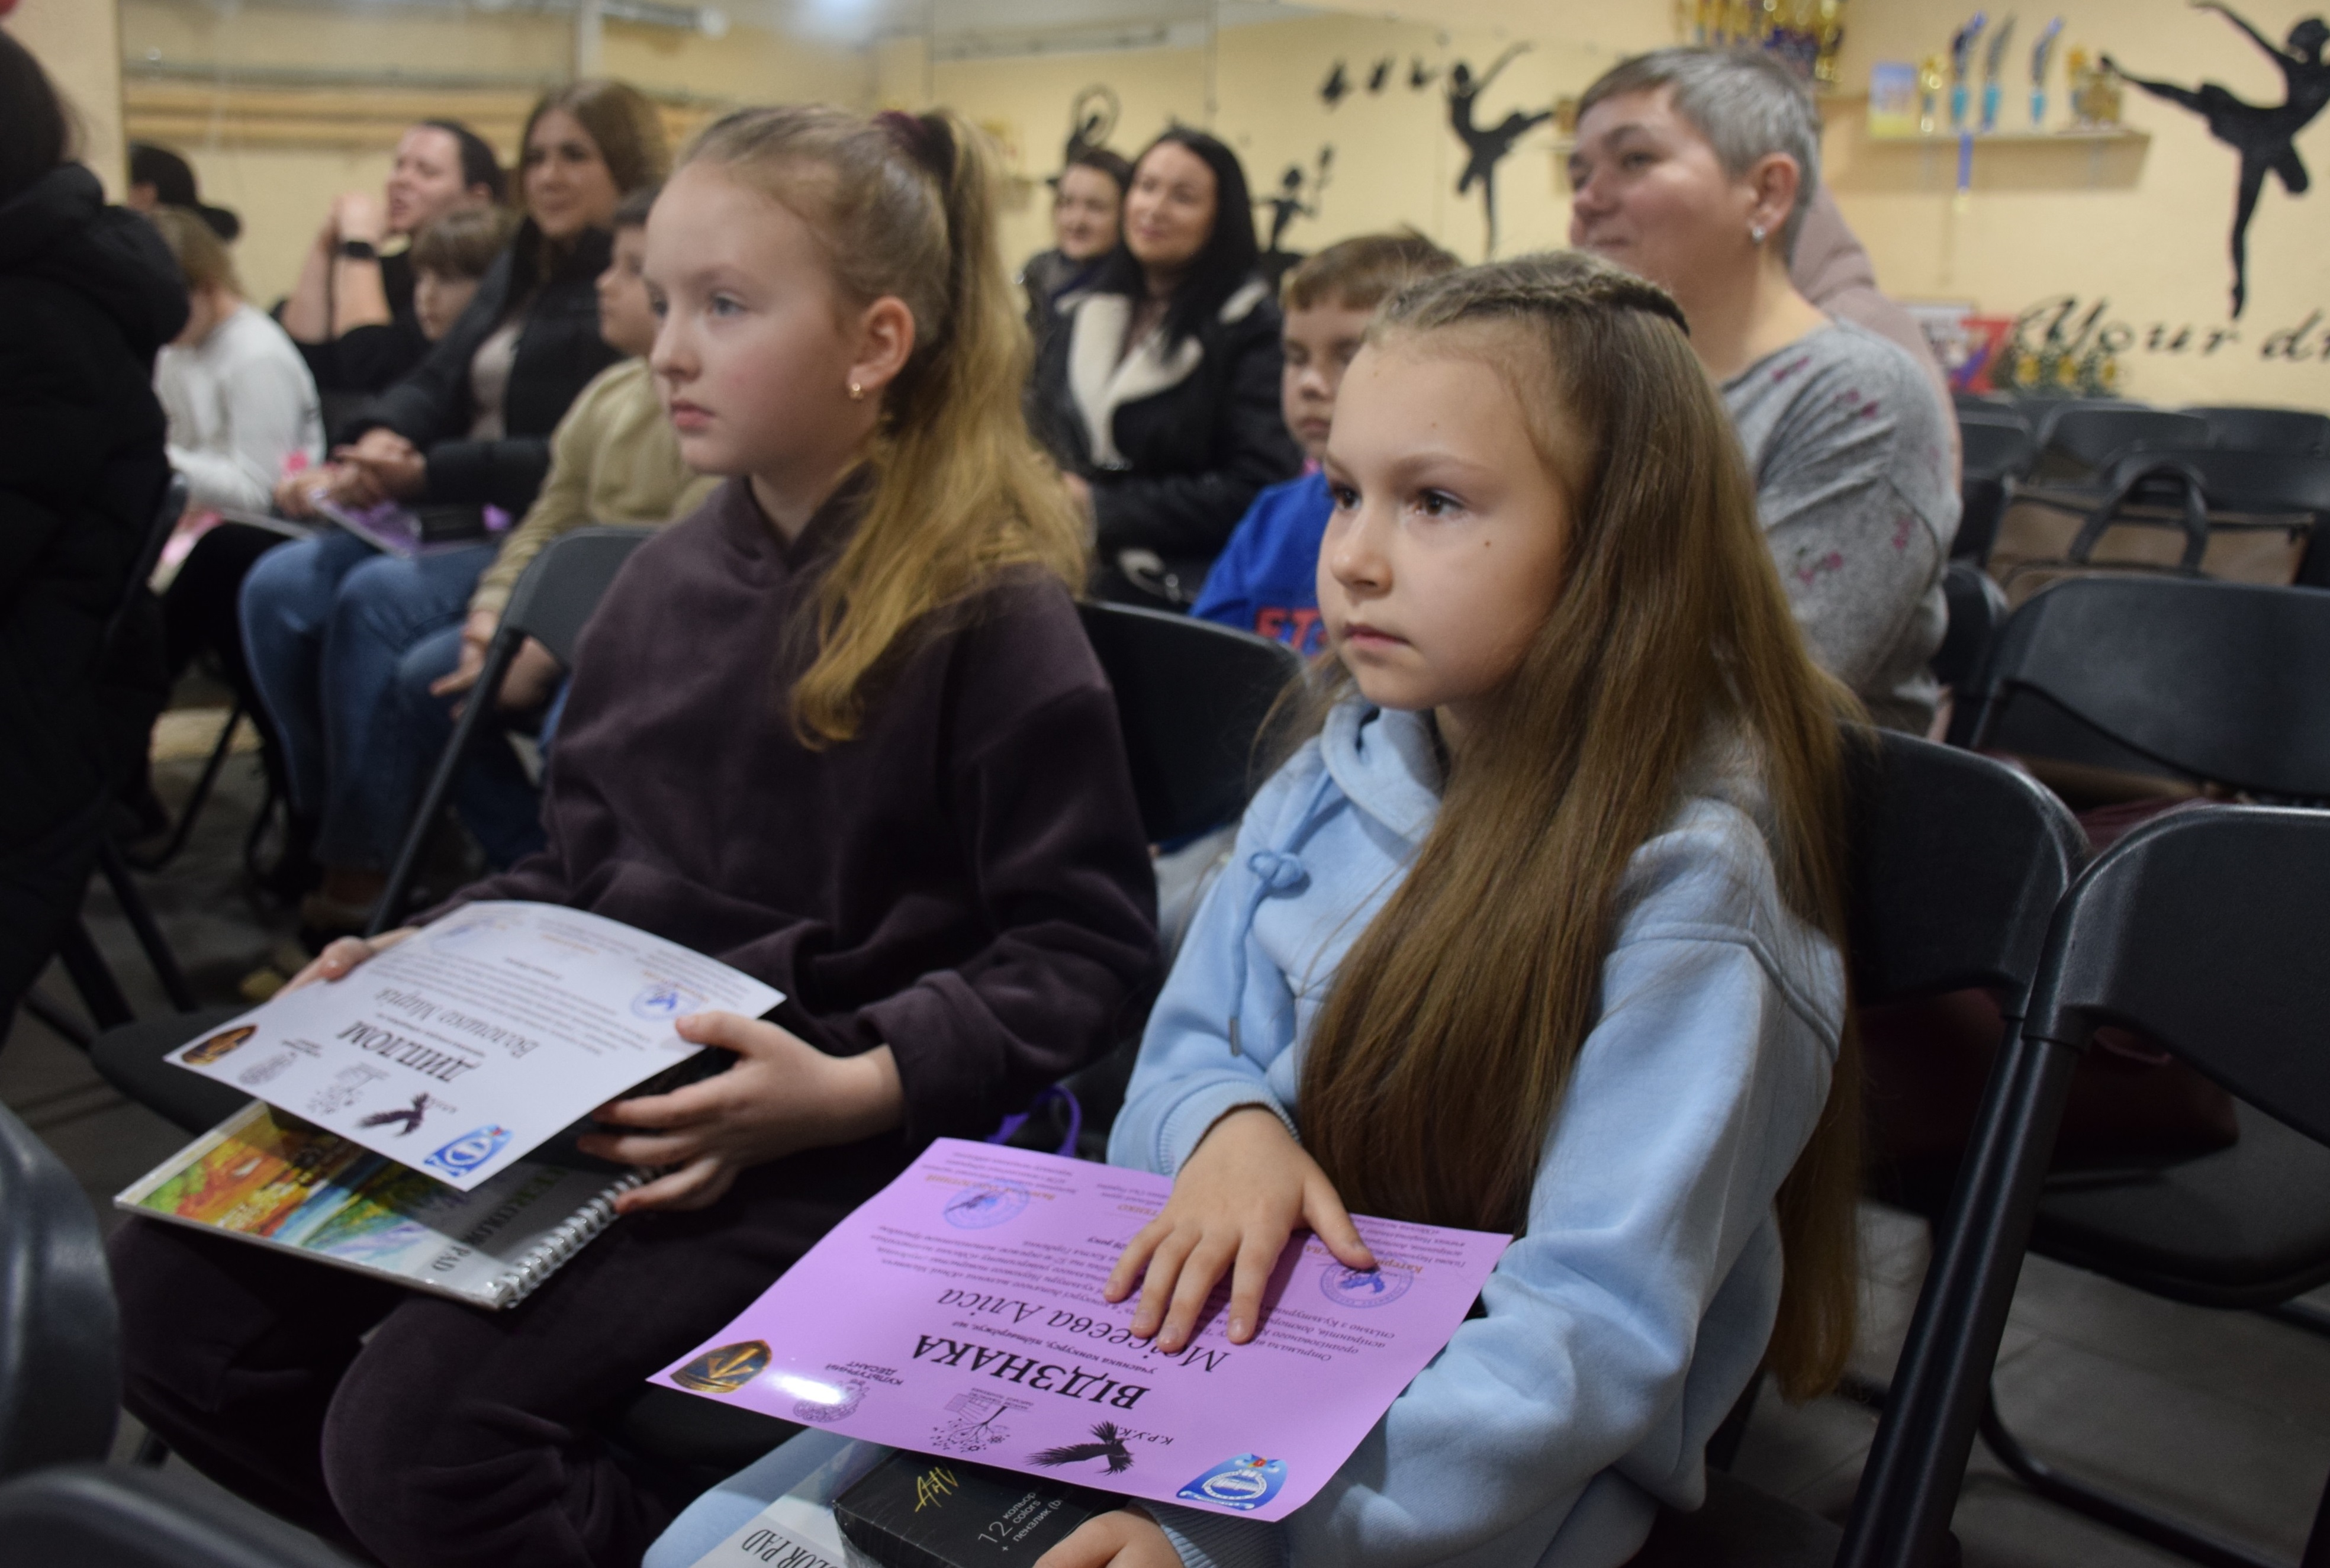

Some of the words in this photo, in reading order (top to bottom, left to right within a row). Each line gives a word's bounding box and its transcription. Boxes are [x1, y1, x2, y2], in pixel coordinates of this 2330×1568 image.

[336, 1019, 481, 1083] ДИПЛОМ
[938, 1289, 1044, 1323] Аліса
[847, 1361, 897, 1376] ДЕСАНТ
[912, 1334, 1151, 1409] ВІДЗНАКА
[978, 1521, 1013, 1543] 12
[1003, 1492, 1035, 1519] кольор
[1013, 1499, 1041, 1524] colors
[1013, 1508, 1052, 1542] пензлик
[742, 1529, 791, 1562] PAD
